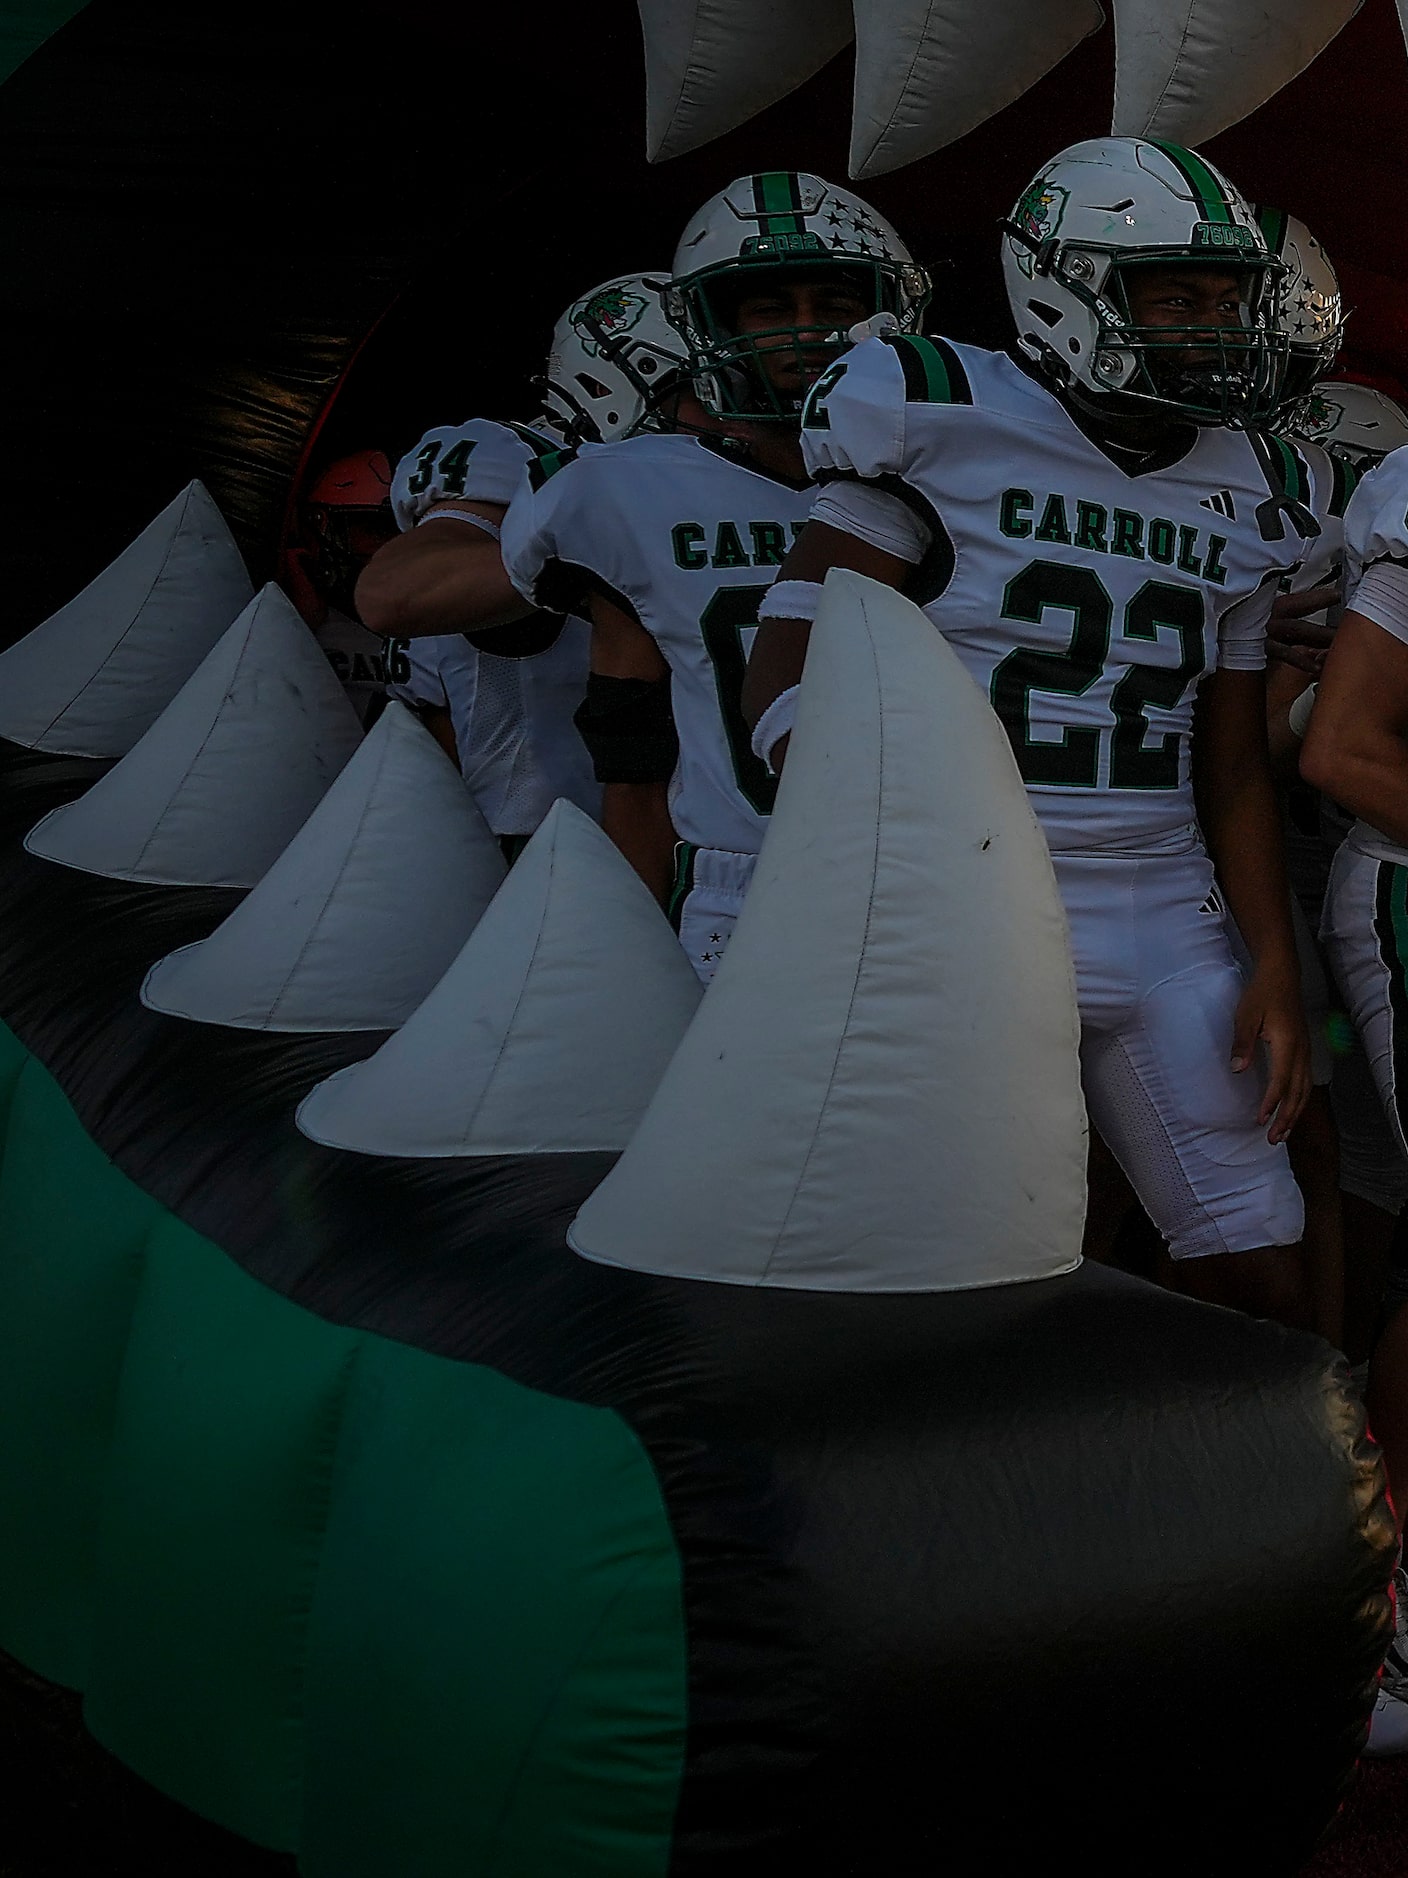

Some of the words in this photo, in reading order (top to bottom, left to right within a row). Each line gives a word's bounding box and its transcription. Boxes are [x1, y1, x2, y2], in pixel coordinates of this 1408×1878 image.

[407, 439, 479, 496] 34
[671, 520, 810, 571] CAR
[999, 487, 1228, 586] CARROLL
[990, 557, 1207, 790] 22
